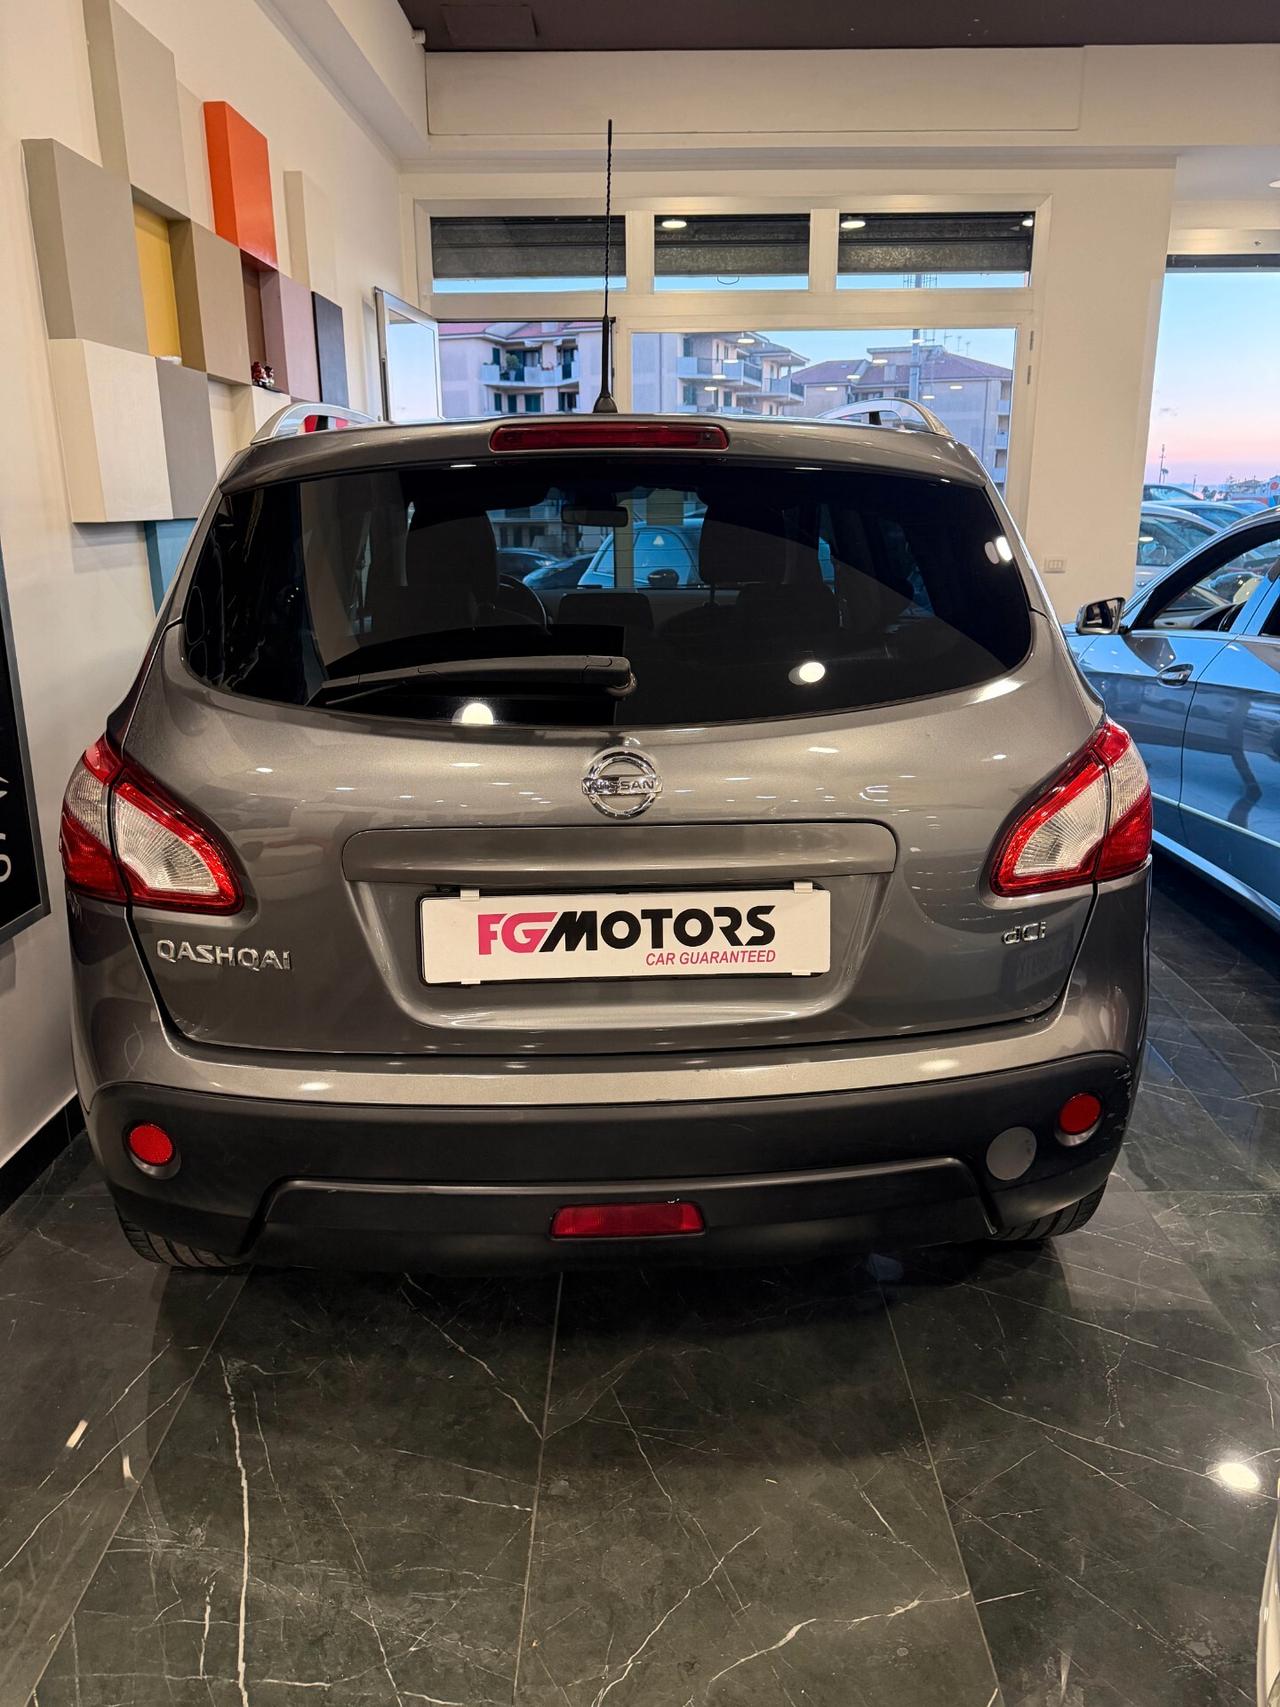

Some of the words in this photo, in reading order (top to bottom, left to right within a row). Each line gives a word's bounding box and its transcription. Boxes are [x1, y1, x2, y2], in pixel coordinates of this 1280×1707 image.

[156, 939, 292, 972] QASHQAI
[646, 952, 676, 966] CAR
[679, 950, 776, 965] GUARANTEED
